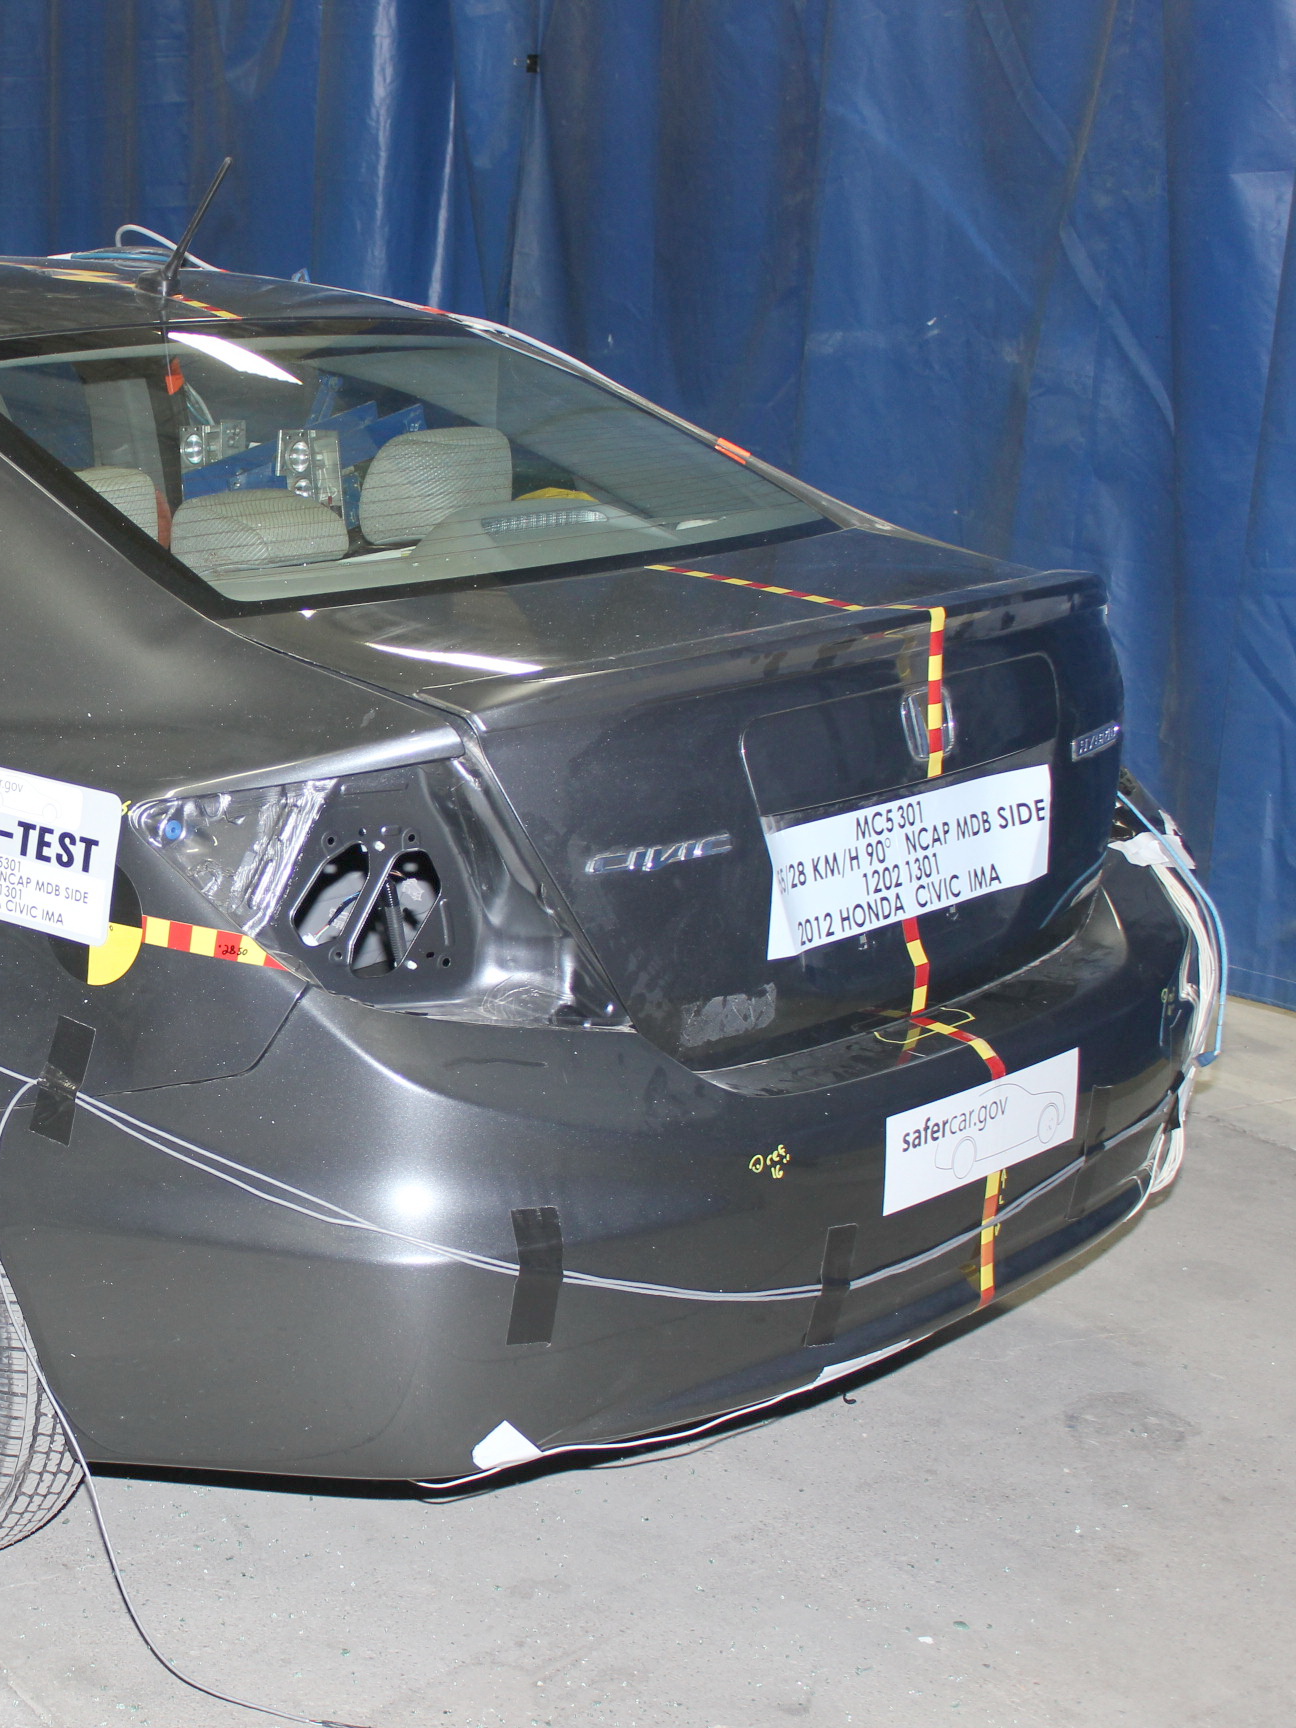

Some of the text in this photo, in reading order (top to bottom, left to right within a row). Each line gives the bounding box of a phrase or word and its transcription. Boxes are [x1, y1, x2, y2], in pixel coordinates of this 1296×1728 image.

[584, 833, 733, 875] CIVIC
[811, 846, 861, 882] KM/H
[865, 837, 892, 867] 90°
[904, 821, 951, 855] NCAP
[956, 810, 992, 841] MDB
[997, 798, 1046, 830] SIDE
[0, 871, 32, 889] NCAP
[35, 882, 61, 898] MDB
[64, 887, 89, 904] SIDE
[797, 863, 1002, 947] 2012 HONDA CIVIC IMA
[5, 900, 38, 919] CIVIC
[42, 908, 64, 926] IMA
[901, 1095, 1008, 1152] safercar.gov
